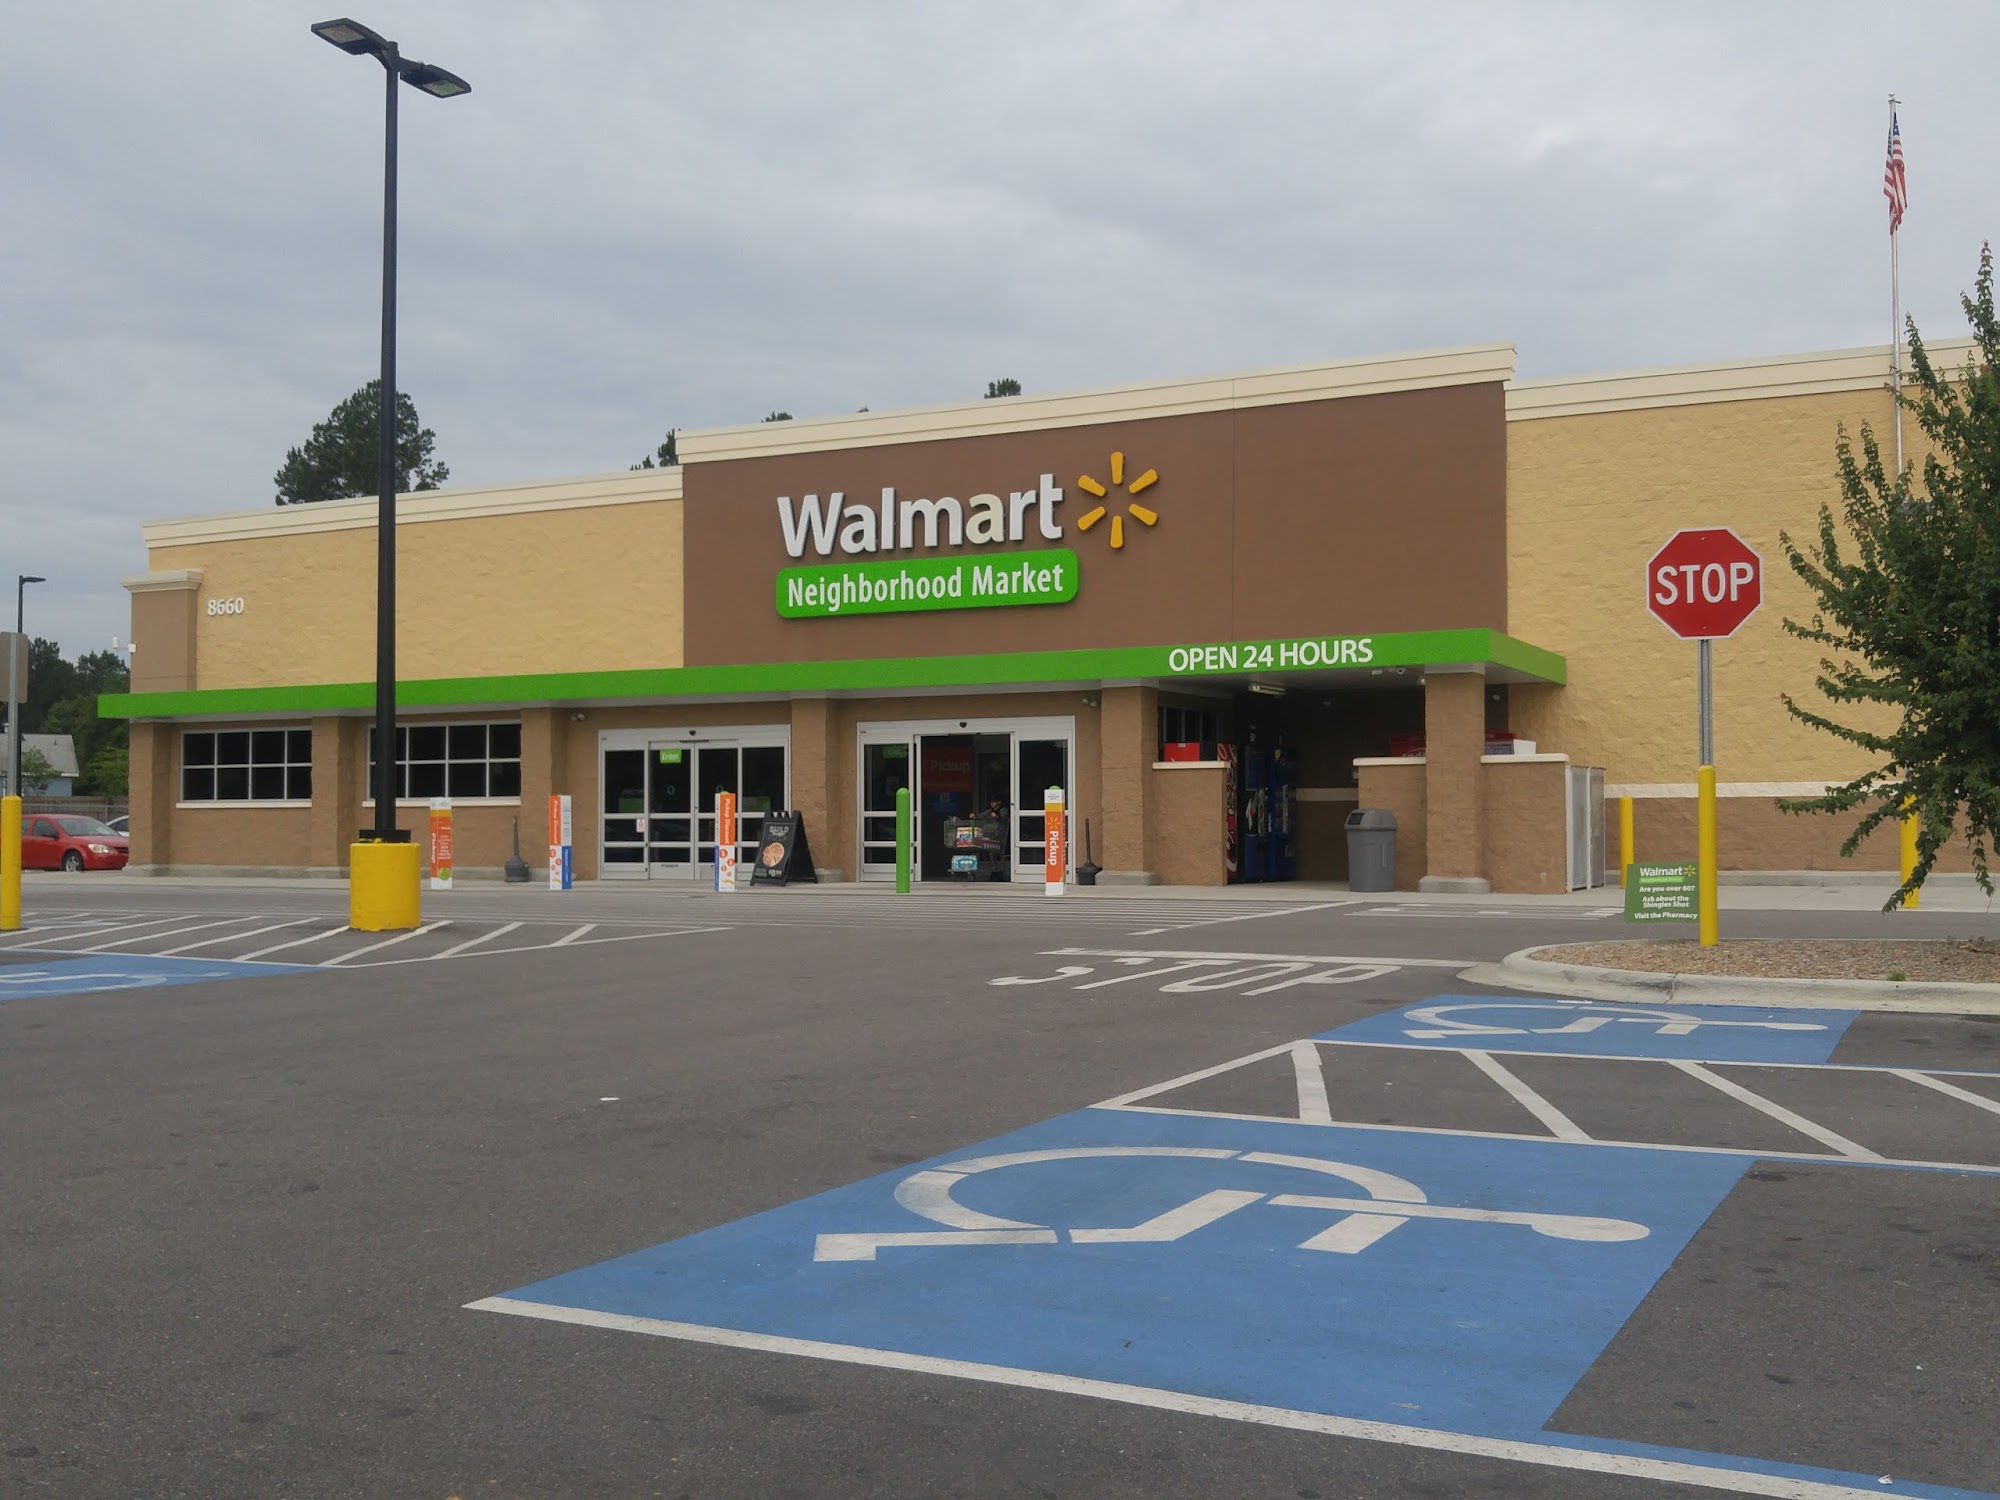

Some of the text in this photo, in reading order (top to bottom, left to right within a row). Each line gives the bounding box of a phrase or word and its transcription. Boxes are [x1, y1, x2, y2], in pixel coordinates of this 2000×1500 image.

[777, 473, 1064, 557] Walmart
[788, 562, 1064, 612] Neighborhood Market
[1655, 562, 1754, 605] STOP
[207, 597, 245, 616] 8660
[1169, 638, 1373, 672] OPEN 24 HOURS
[930, 759, 970, 773] Pickup
[1048, 830, 1059, 866] Pickup
[1640, 866, 1683, 876] Walmart
[1643, 901, 1671, 909] Shingles
[1662, 911, 1698, 920] Pharmacy
[985, 957, 1402, 996] STOP
